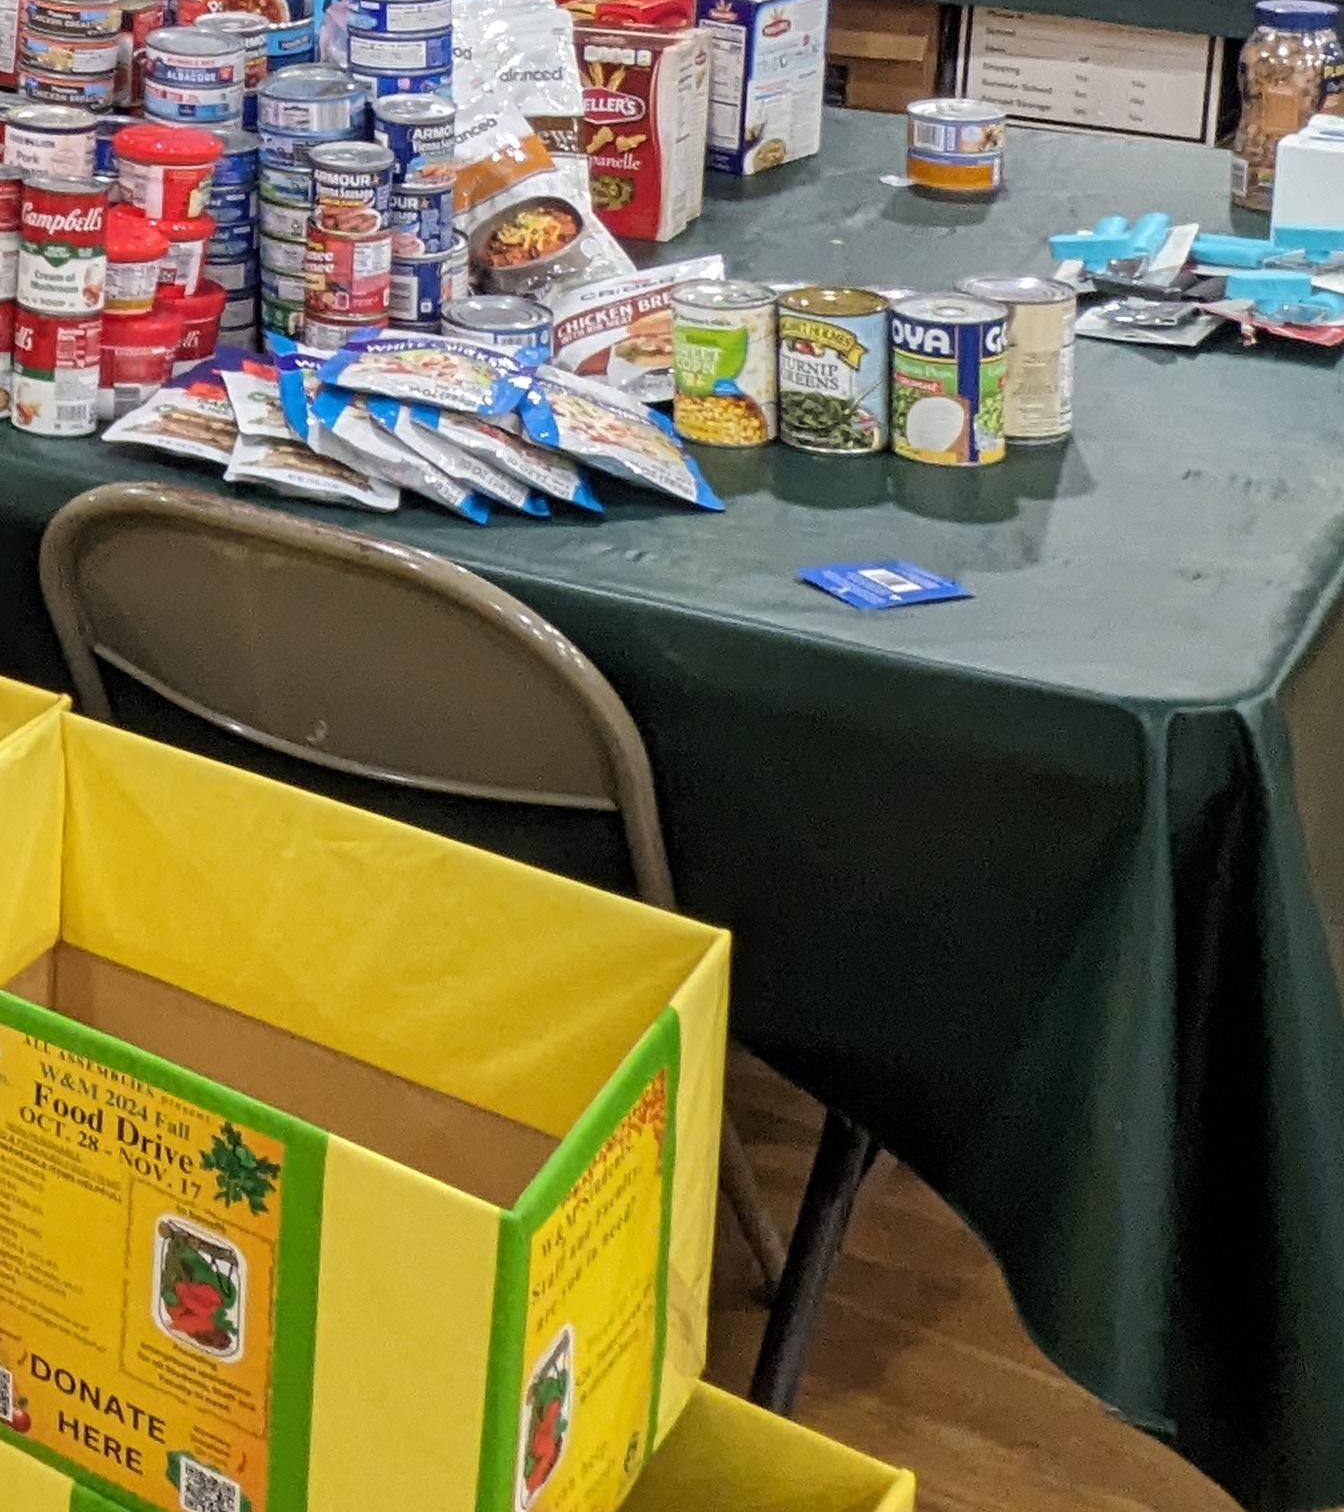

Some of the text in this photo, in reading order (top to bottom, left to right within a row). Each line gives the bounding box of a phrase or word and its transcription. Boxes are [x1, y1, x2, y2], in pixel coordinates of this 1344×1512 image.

[16, 150, 39, 165] Pork
[314, 170, 372, 187] ARMOUR
[34, 269, 64, 281] Cream
[556, 292, 672, 339] CHICKEN BRE
[891, 318, 951, 355] OYA
[781, 354, 839, 376] TURNIP
[23, 1035, 155, 1099] ALL ASSEMBLIES
[33, 1079, 195, 1176] Food Drive
[39, 1061, 191, 1142] W&M 2024 Fall
[19, 1105, 202, 1200] OCT. 28 17
[29, 1352, 167, 1445] DONATE
[57, 1410, 145, 1477] HERE
